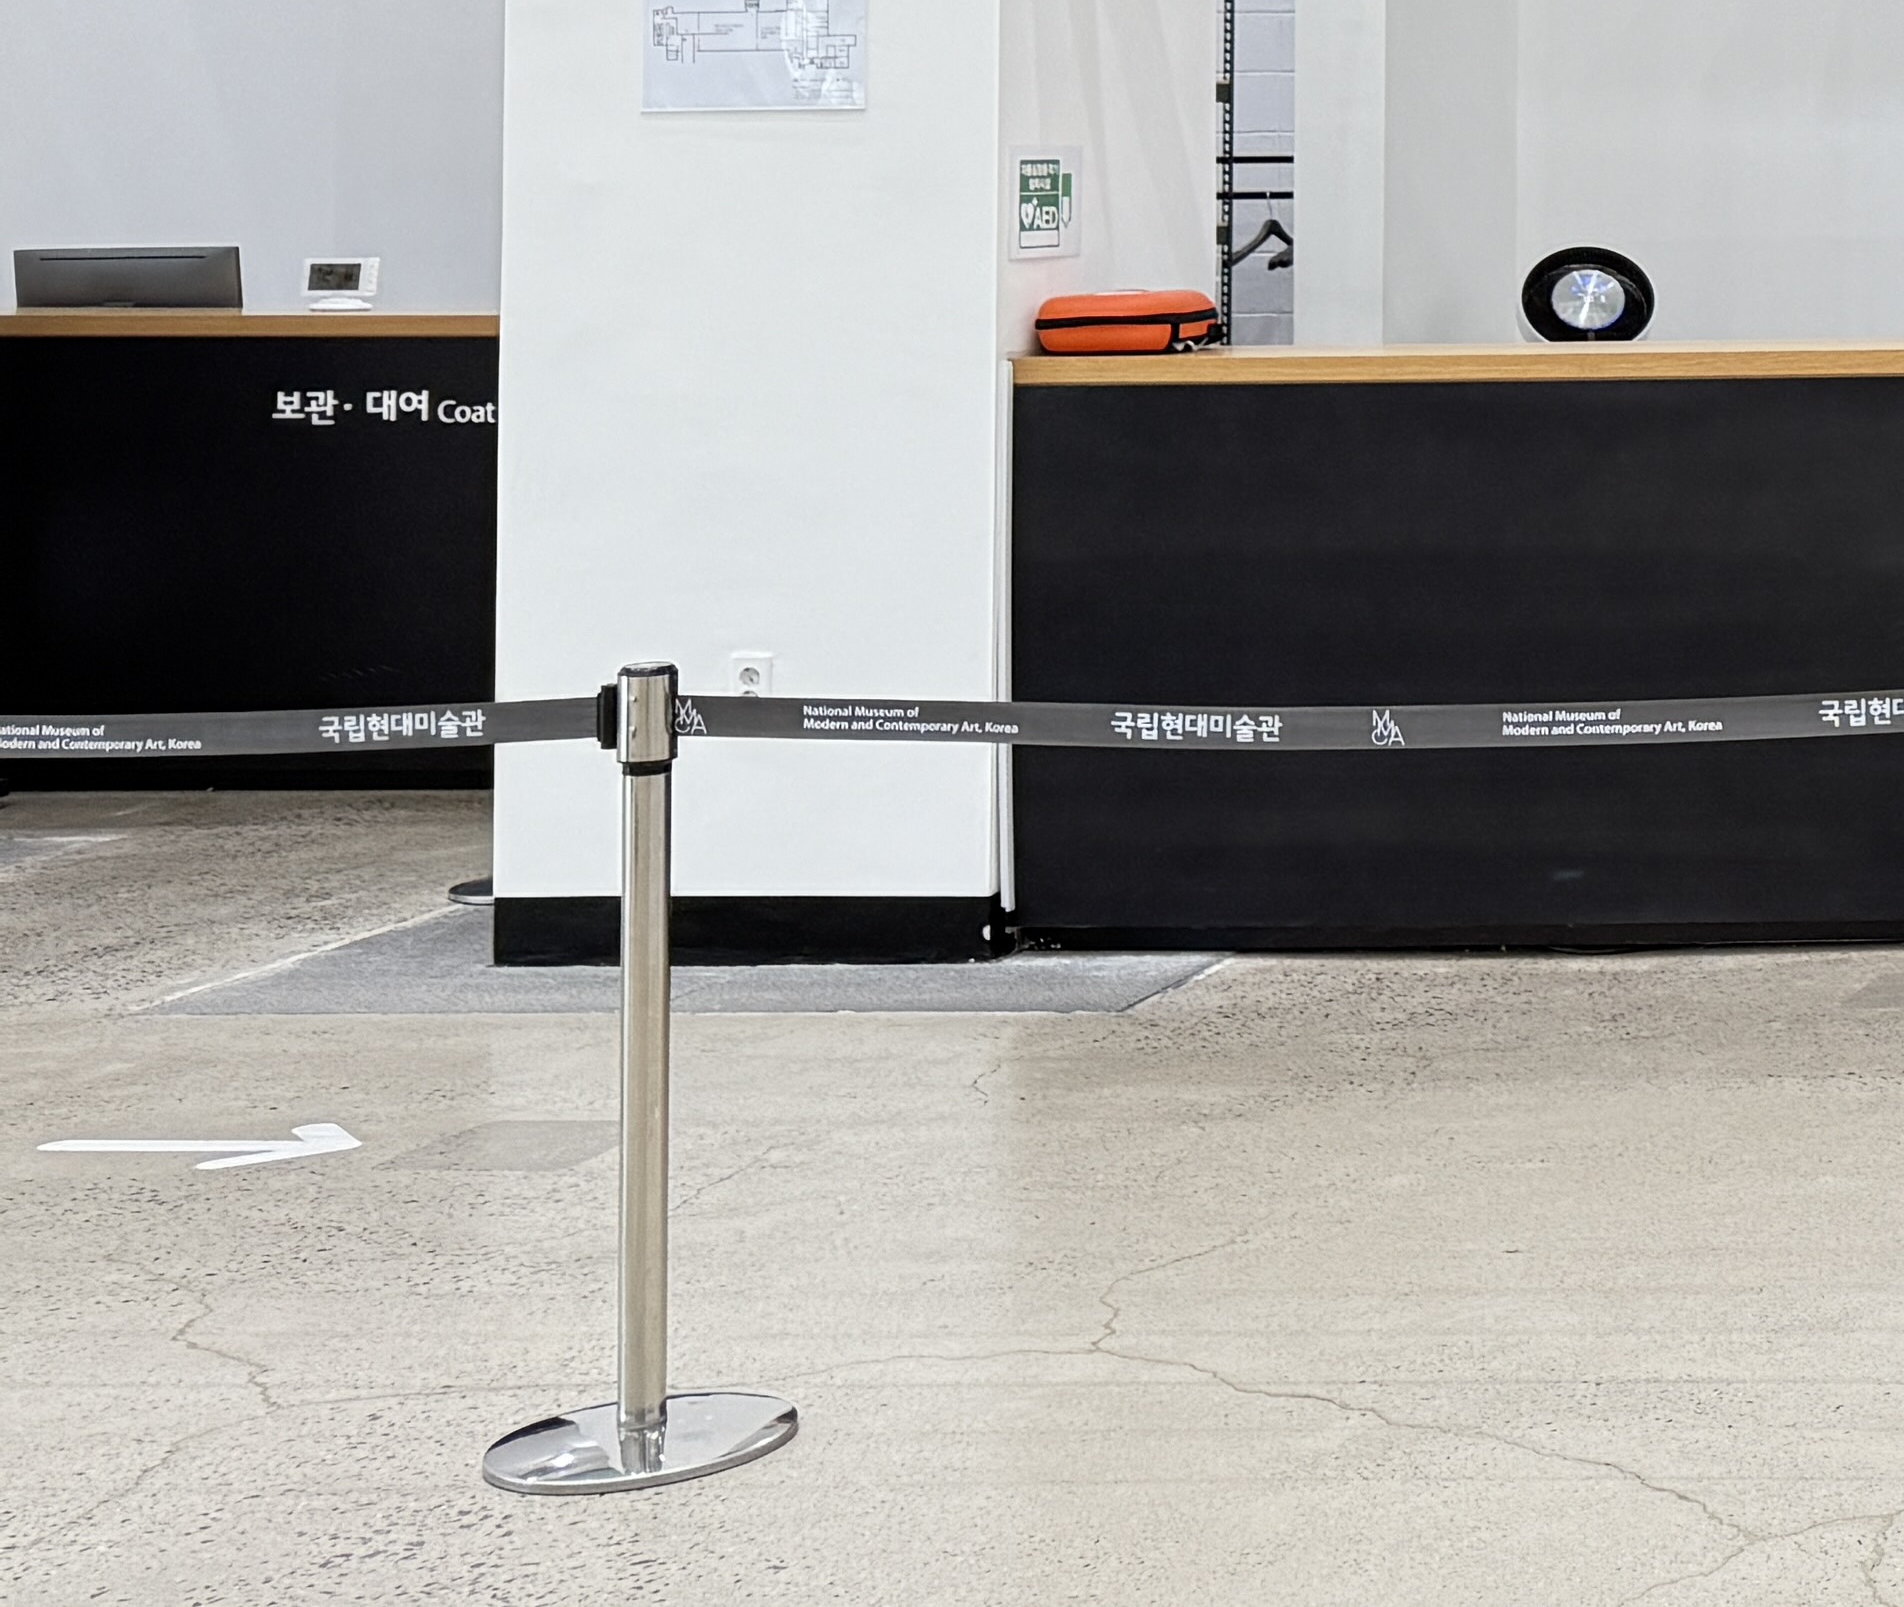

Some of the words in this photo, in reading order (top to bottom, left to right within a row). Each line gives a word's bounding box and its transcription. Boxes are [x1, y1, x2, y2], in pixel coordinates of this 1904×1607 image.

[1034, 206, 1058, 229] AED
[367, 390, 428, 421] 대여
[438, 400, 495, 423] Coat
[803, 706, 852, 716] National
[855, 707, 904, 717] Museum
[907, 707, 919, 717] of
[1502, 711, 1553, 723] National
[1555, 710, 1606, 721] Museum
[1608, 709, 1621, 721] of
[0, 725, 39, 736] ational
[42, 725, 90, 736] Museum
[92, 725, 104, 736] of
[319, 709, 486, 743] 국립현대미술관
[803, 719, 848, 730] Modern
[851, 719, 873, 730] and
[875, 719, 959, 734] Contemporary
[985, 722, 1019, 734] Korea
[1111, 712, 1282, 742] 국립현대미술관
[1502, 725, 1549, 736] Modern
[1551, 724, 1574, 735] and
[1577, 723, 1661, 736] Contemporary
[1688, 721, 1723, 731] Korea
[38, 739, 59, 749] and
[62, 739, 142, 753] Contemporary
[168, 739, 201, 750] Korea
